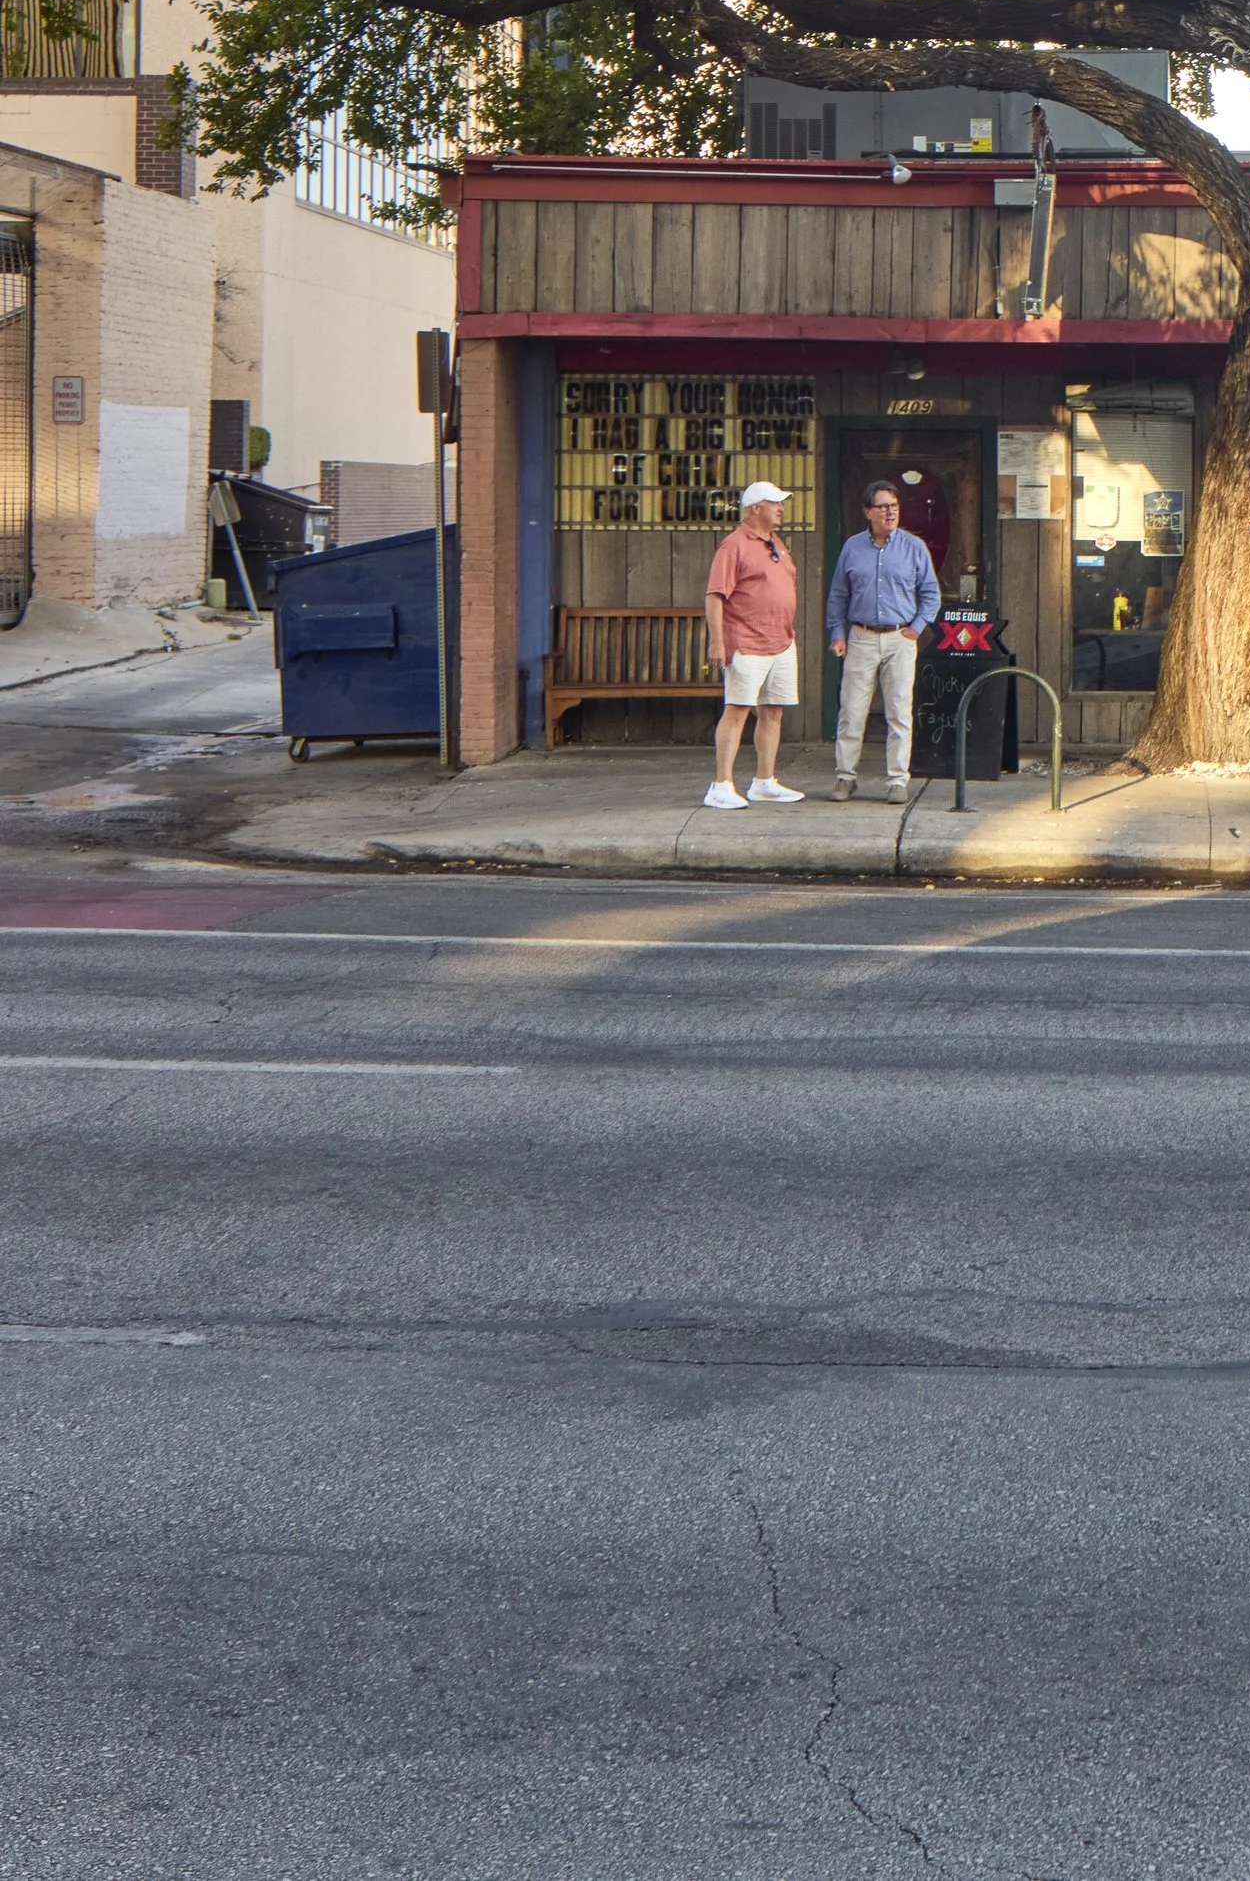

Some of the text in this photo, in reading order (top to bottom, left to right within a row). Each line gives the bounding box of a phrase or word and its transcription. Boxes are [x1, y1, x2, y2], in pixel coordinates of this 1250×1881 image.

[566, 382, 814, 415] SORRY YOUR HONOR
[891, 400, 932, 414] 1409
[571, 418, 809, 450] I HAD A BIG BOWL
[613, 454, 731, 486] OF CHILI
[594, 490, 741, 522] FOR LUNCH
[944, 611, 989, 622] DOS EQUIS
[937, 622, 994, 651] XX
